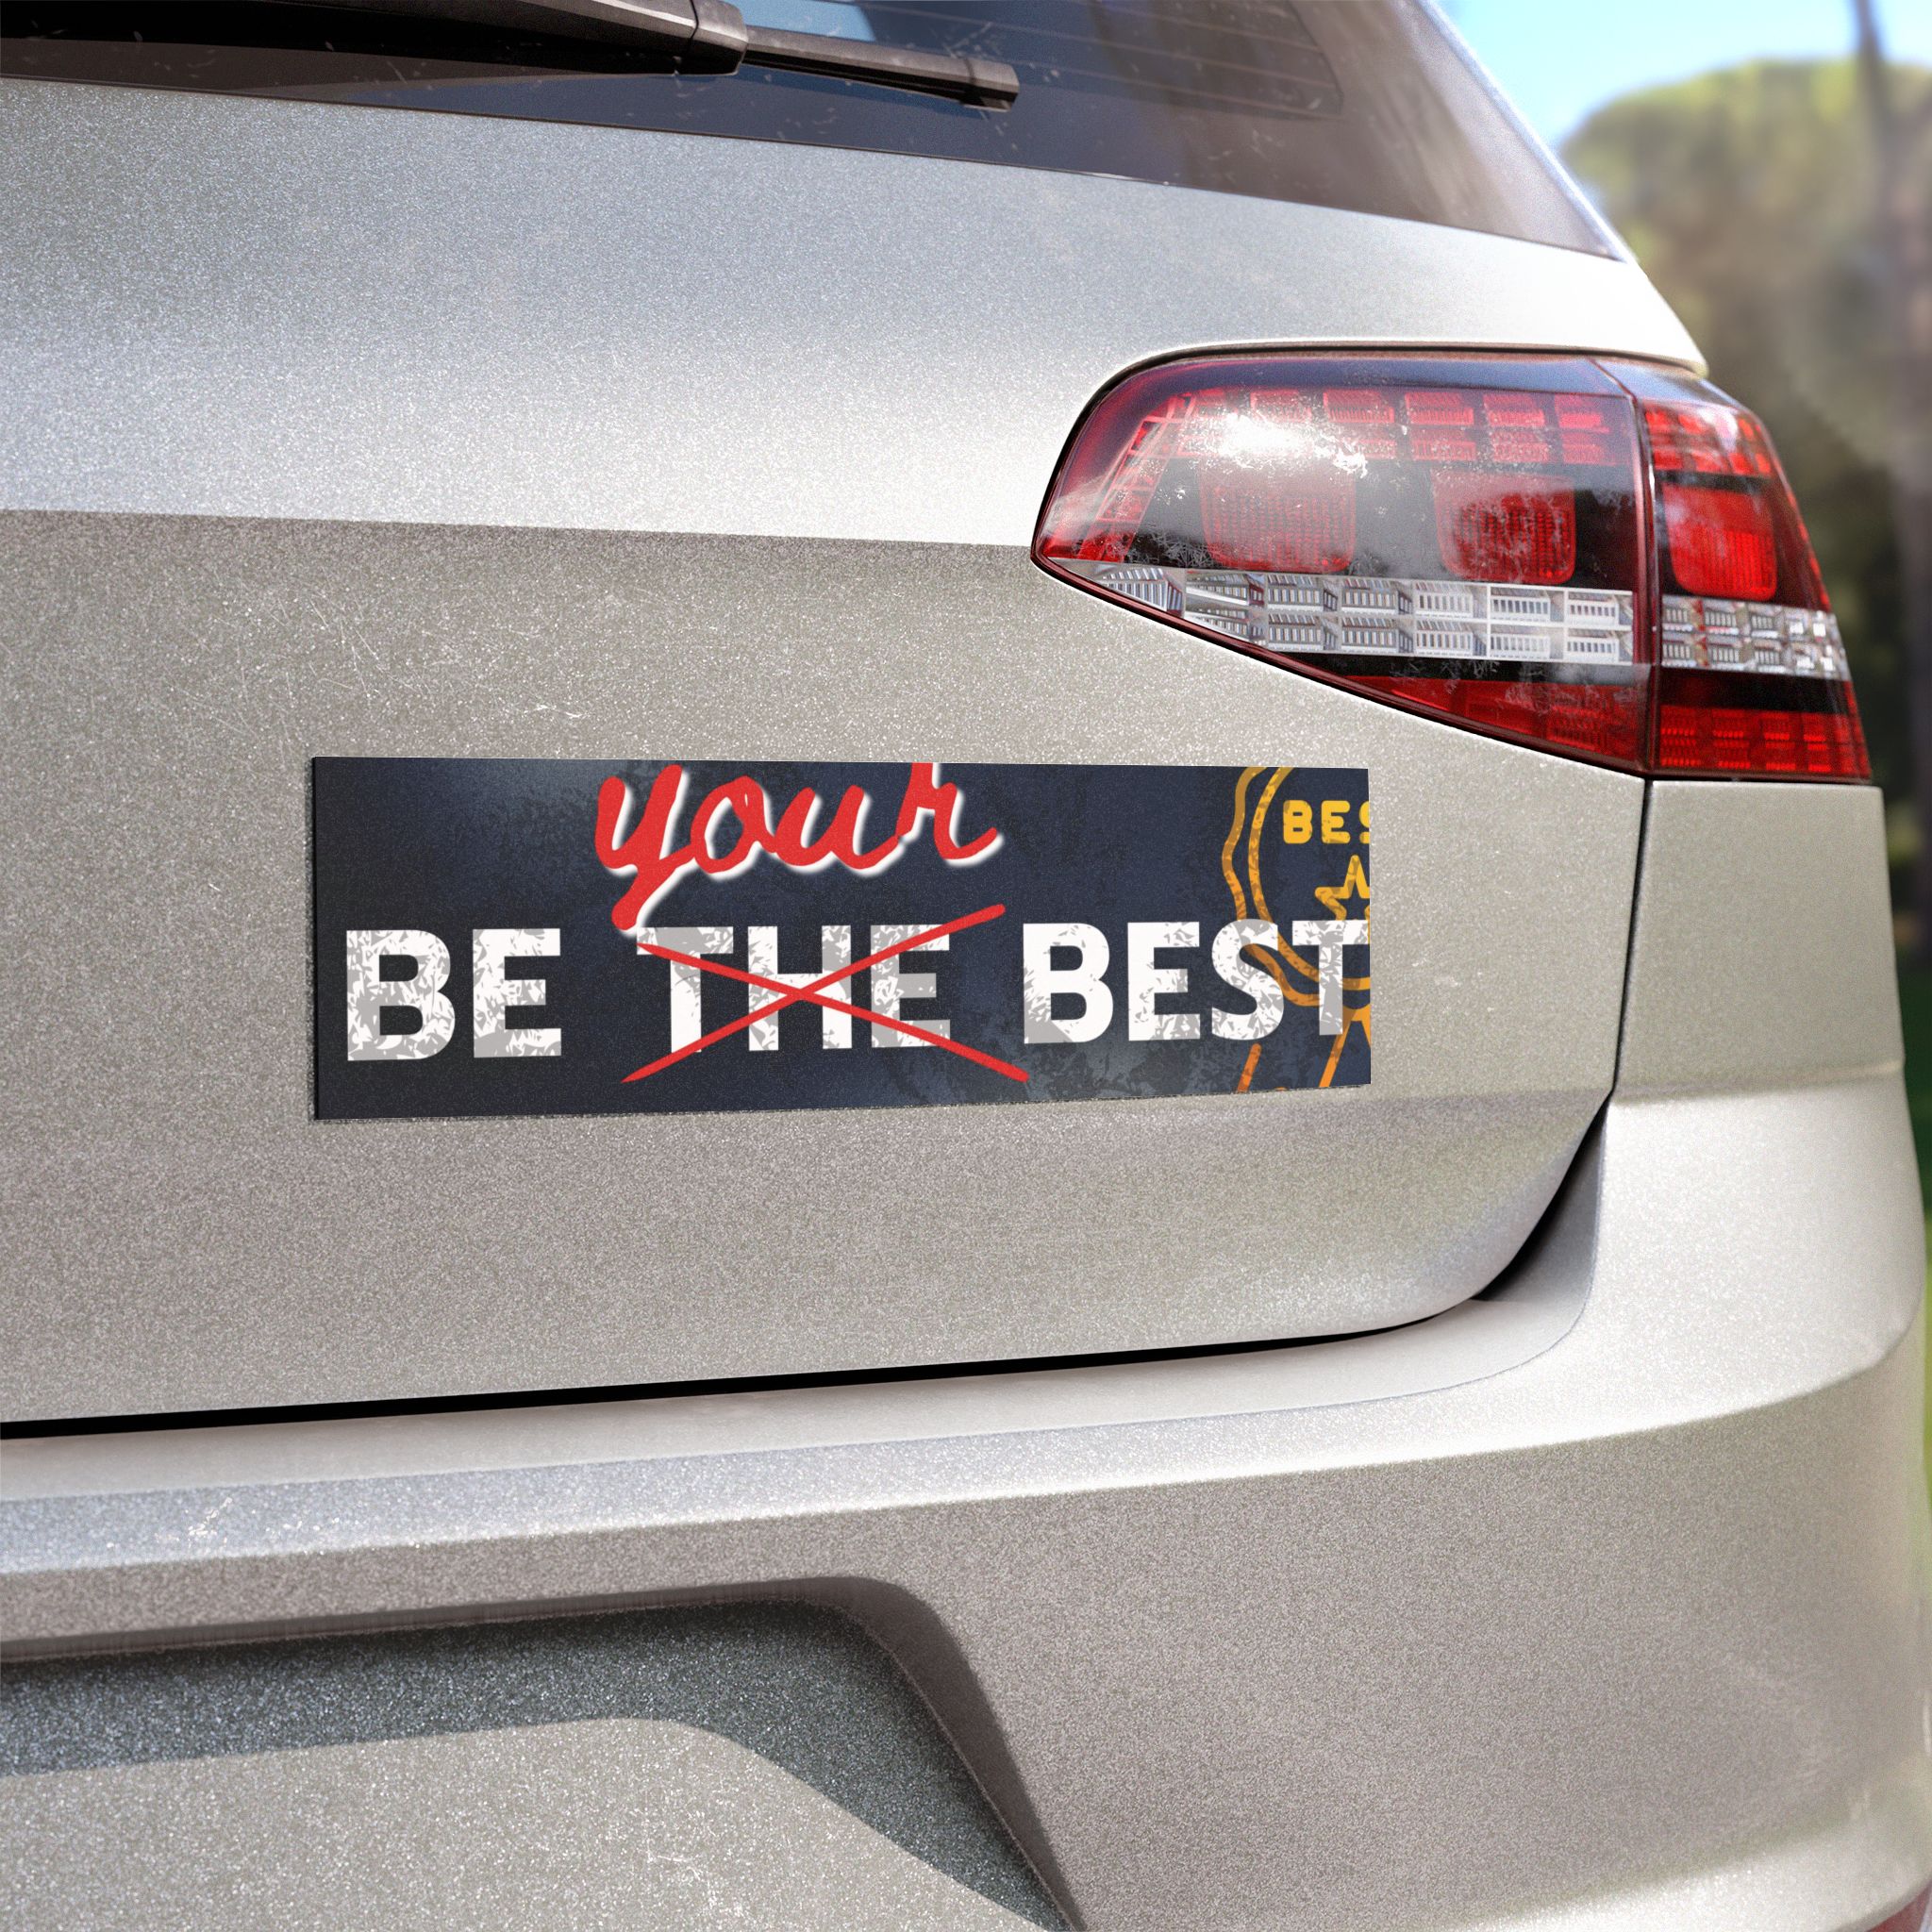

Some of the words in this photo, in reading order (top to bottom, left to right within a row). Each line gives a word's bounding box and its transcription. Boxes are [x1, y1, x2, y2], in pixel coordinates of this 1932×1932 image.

[594, 762, 1003, 935] your
[346, 928, 562, 1061] BE
[636, 924, 951, 1052] THE
[1023, 918, 1369, 1044] BEST
